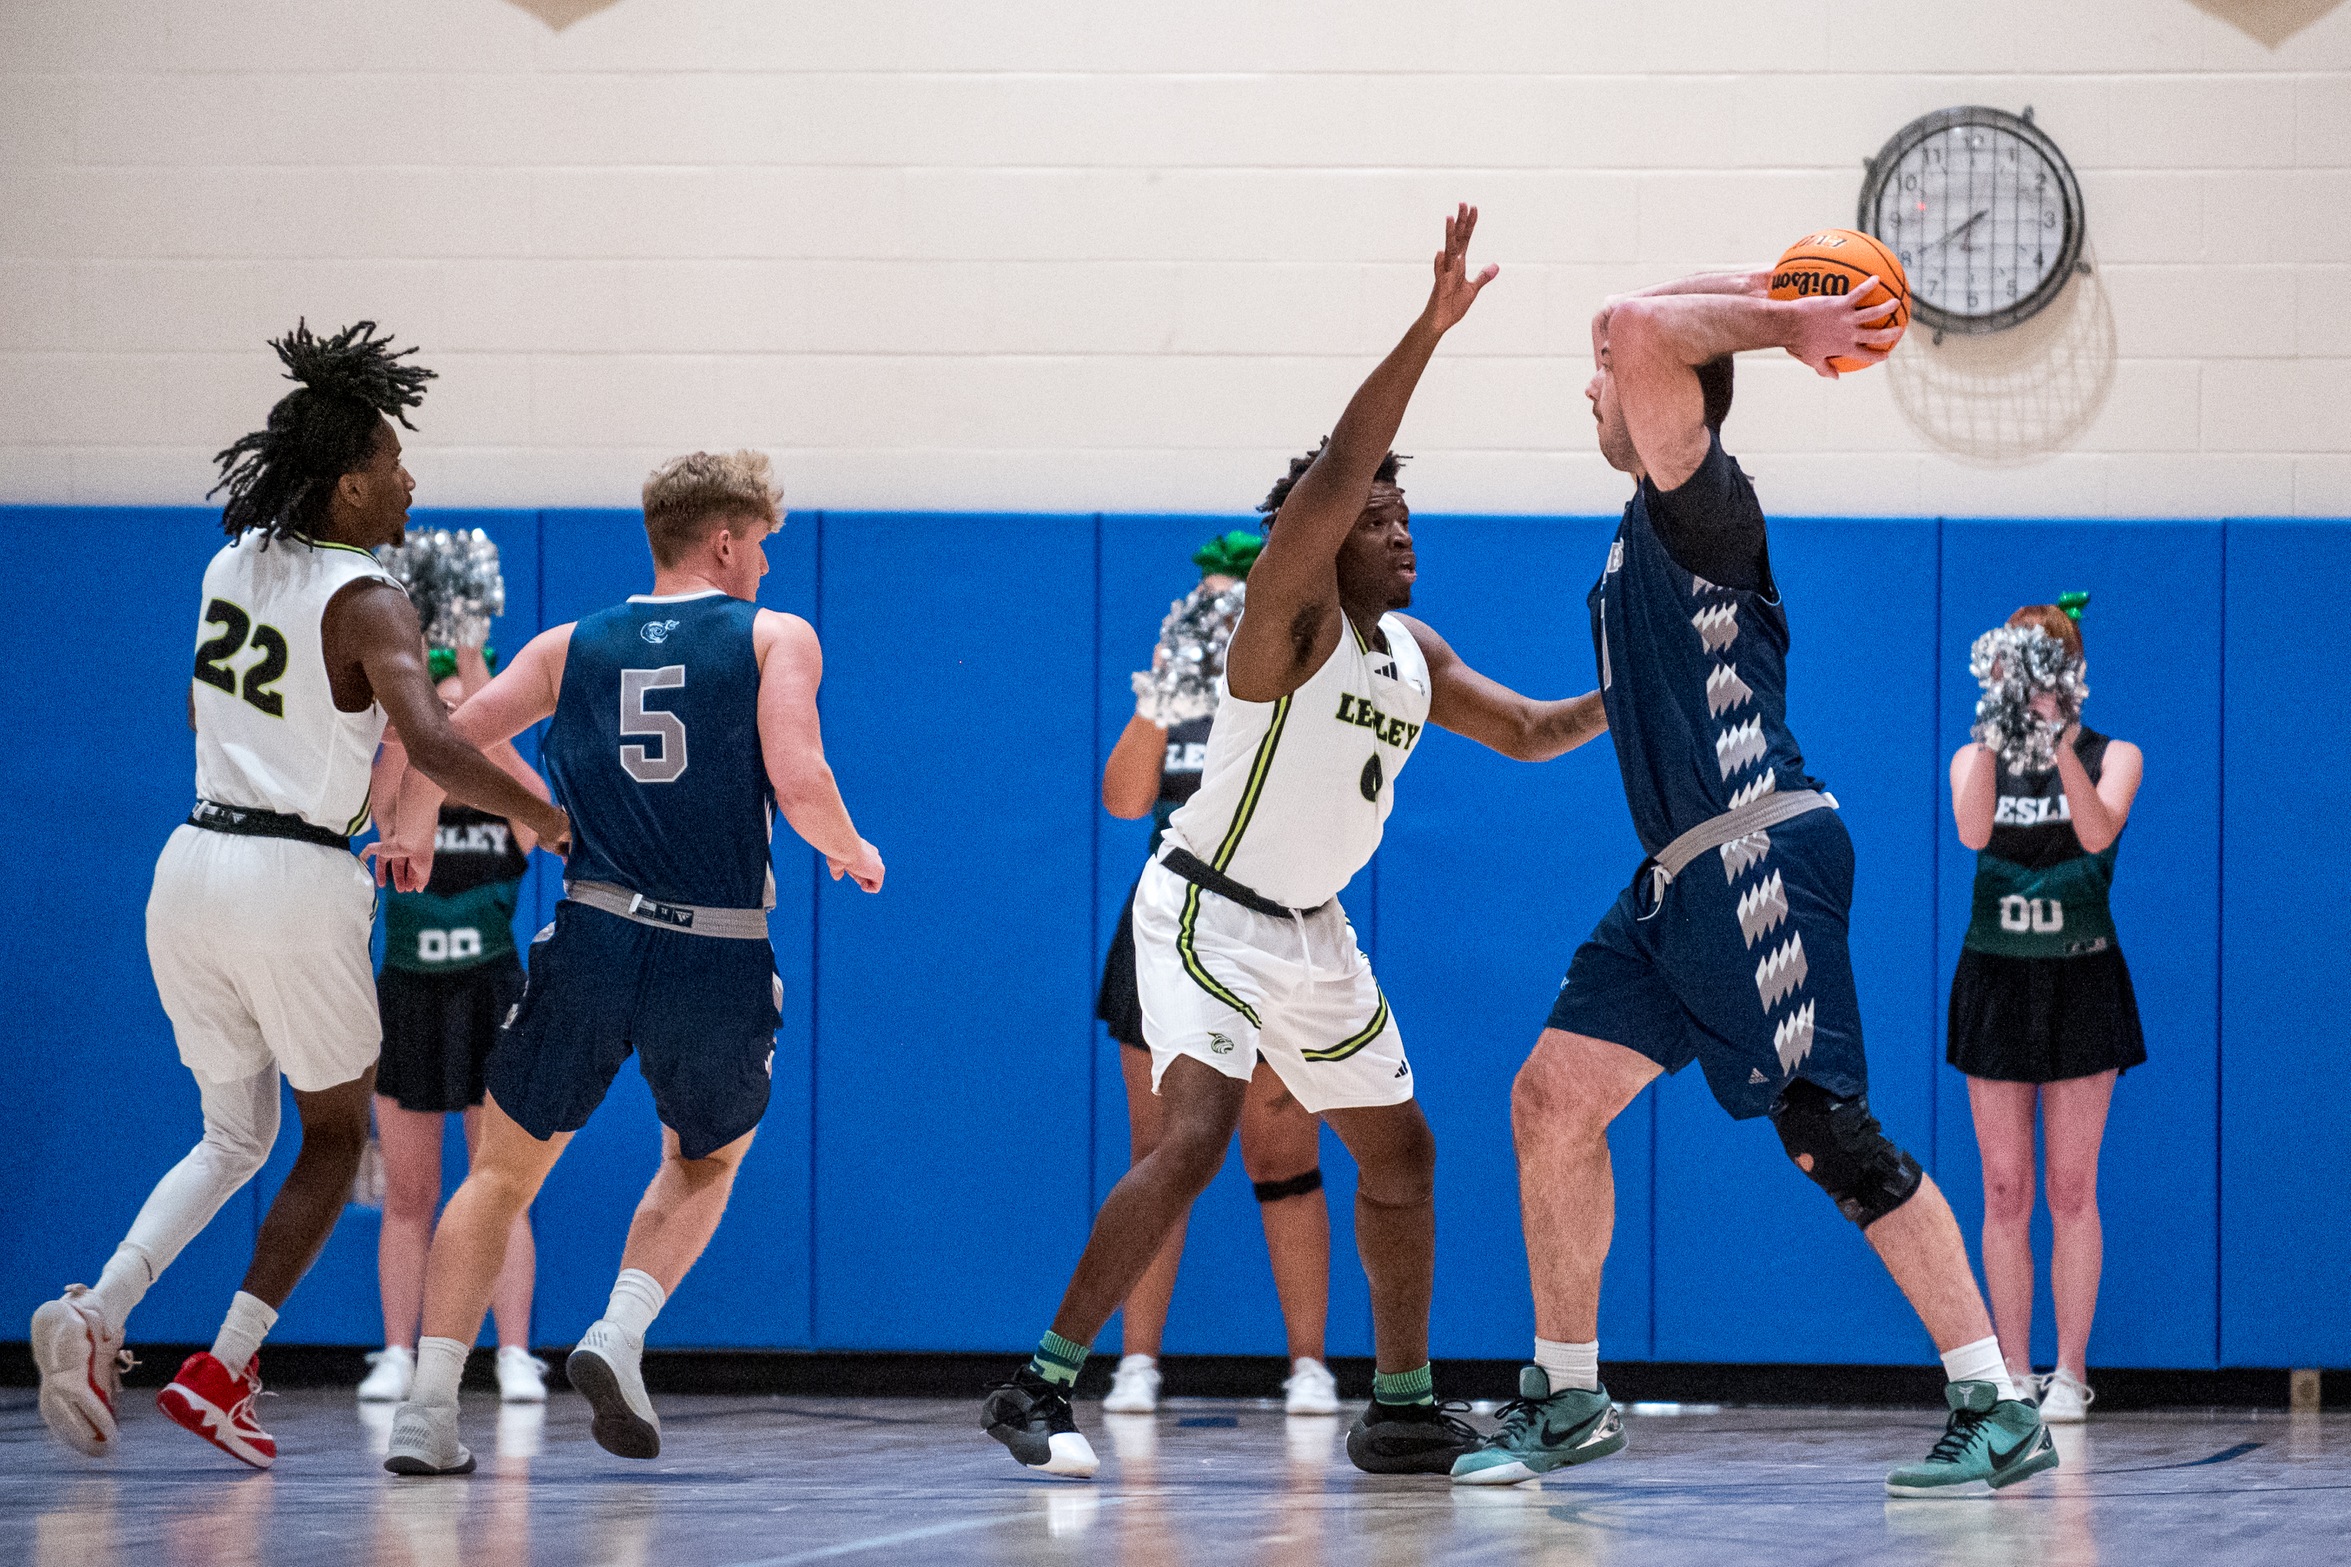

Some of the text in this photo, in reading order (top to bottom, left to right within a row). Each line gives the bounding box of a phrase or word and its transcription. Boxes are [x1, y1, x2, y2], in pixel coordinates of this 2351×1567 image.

[1922, 147, 1941, 164] 11
[2043, 210, 2056, 229] 3
[1772, 271, 1850, 296] Wilson
[194, 598, 289, 720] 22
[620, 665, 688, 783] 5
[1335, 692, 1421, 750] LELEY
